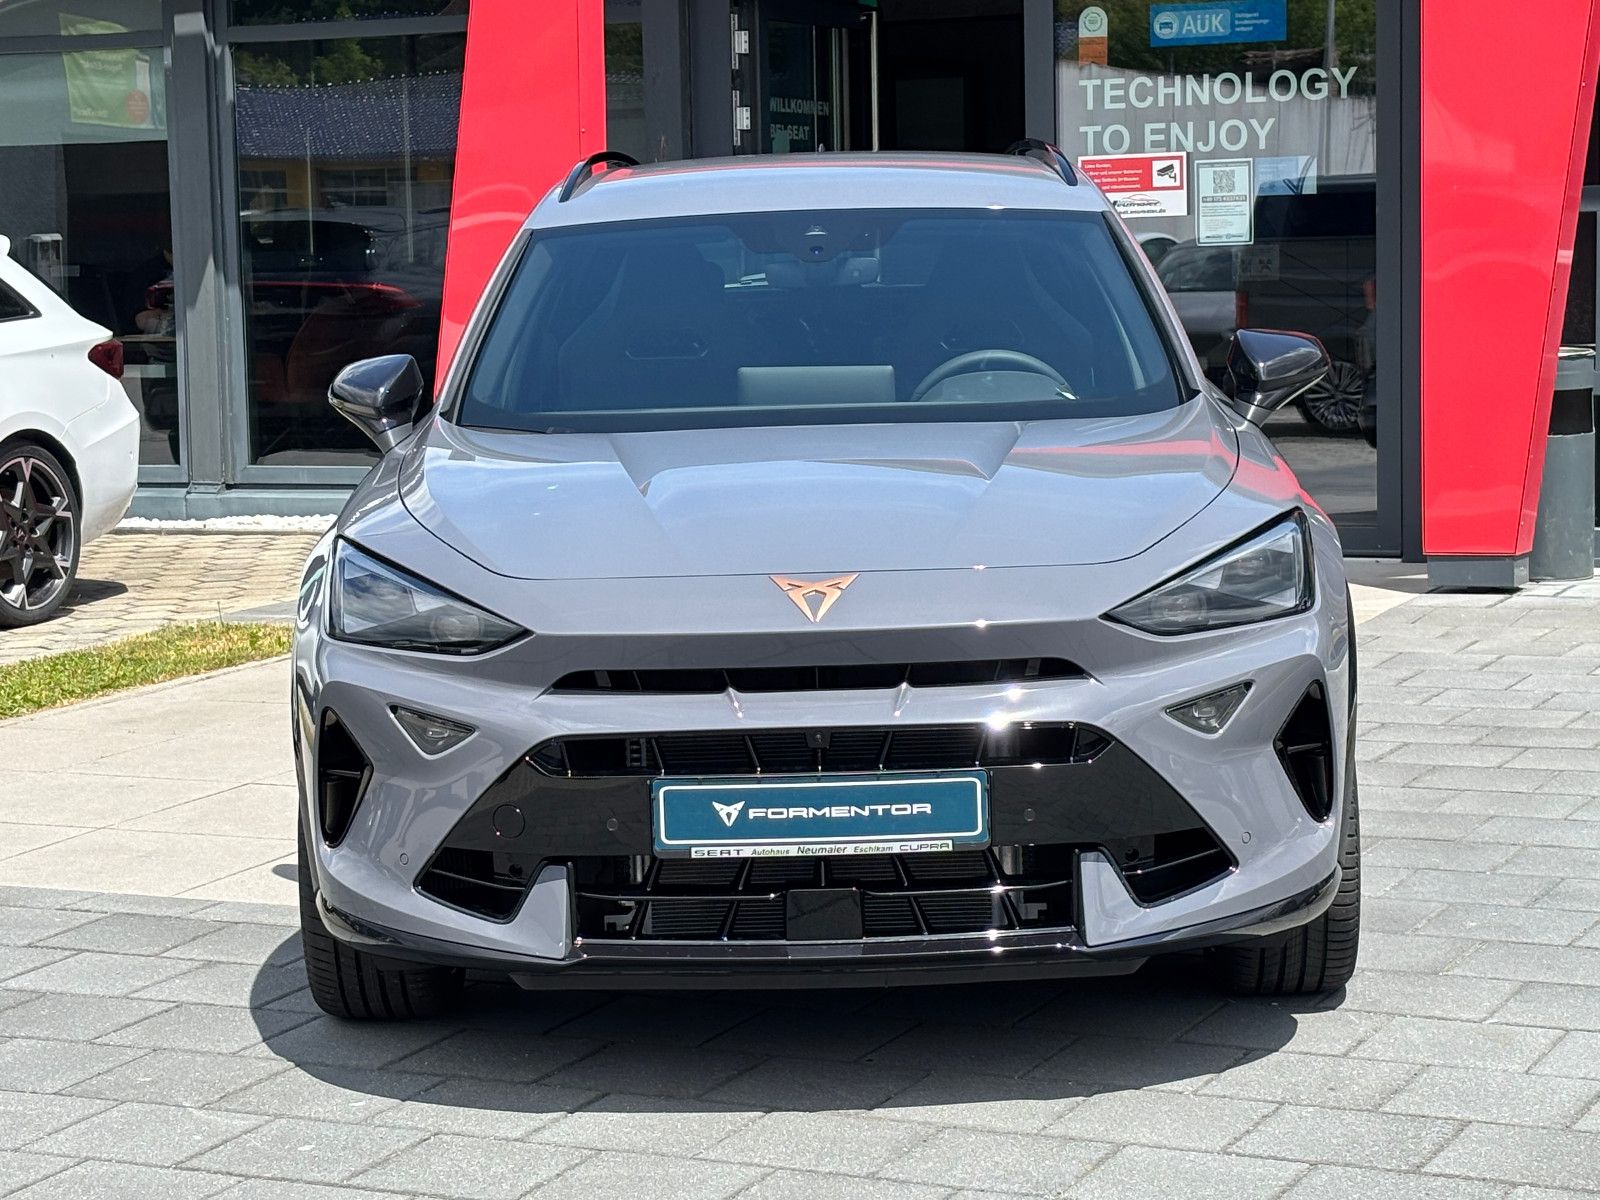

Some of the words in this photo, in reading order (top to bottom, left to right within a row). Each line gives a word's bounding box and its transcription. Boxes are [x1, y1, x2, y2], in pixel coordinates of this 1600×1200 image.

[1182, 13, 1225, 34] AÜK
[1079, 66, 1358, 110] TECHNOLOGY
[770, 97, 829, 117] WILLKOMMEN
[787, 125, 809, 141] SEAT
[1079, 124, 1130, 154] TO
[1144, 118, 1275, 153] ENJOY
[748, 803, 932, 819] FORMENTOR
[694, 848, 744, 857] SEAT
[751, 847, 790, 856] Autohaus
[796, 844, 848, 855] Neumaier
[899, 842, 950, 852] CUPRA
